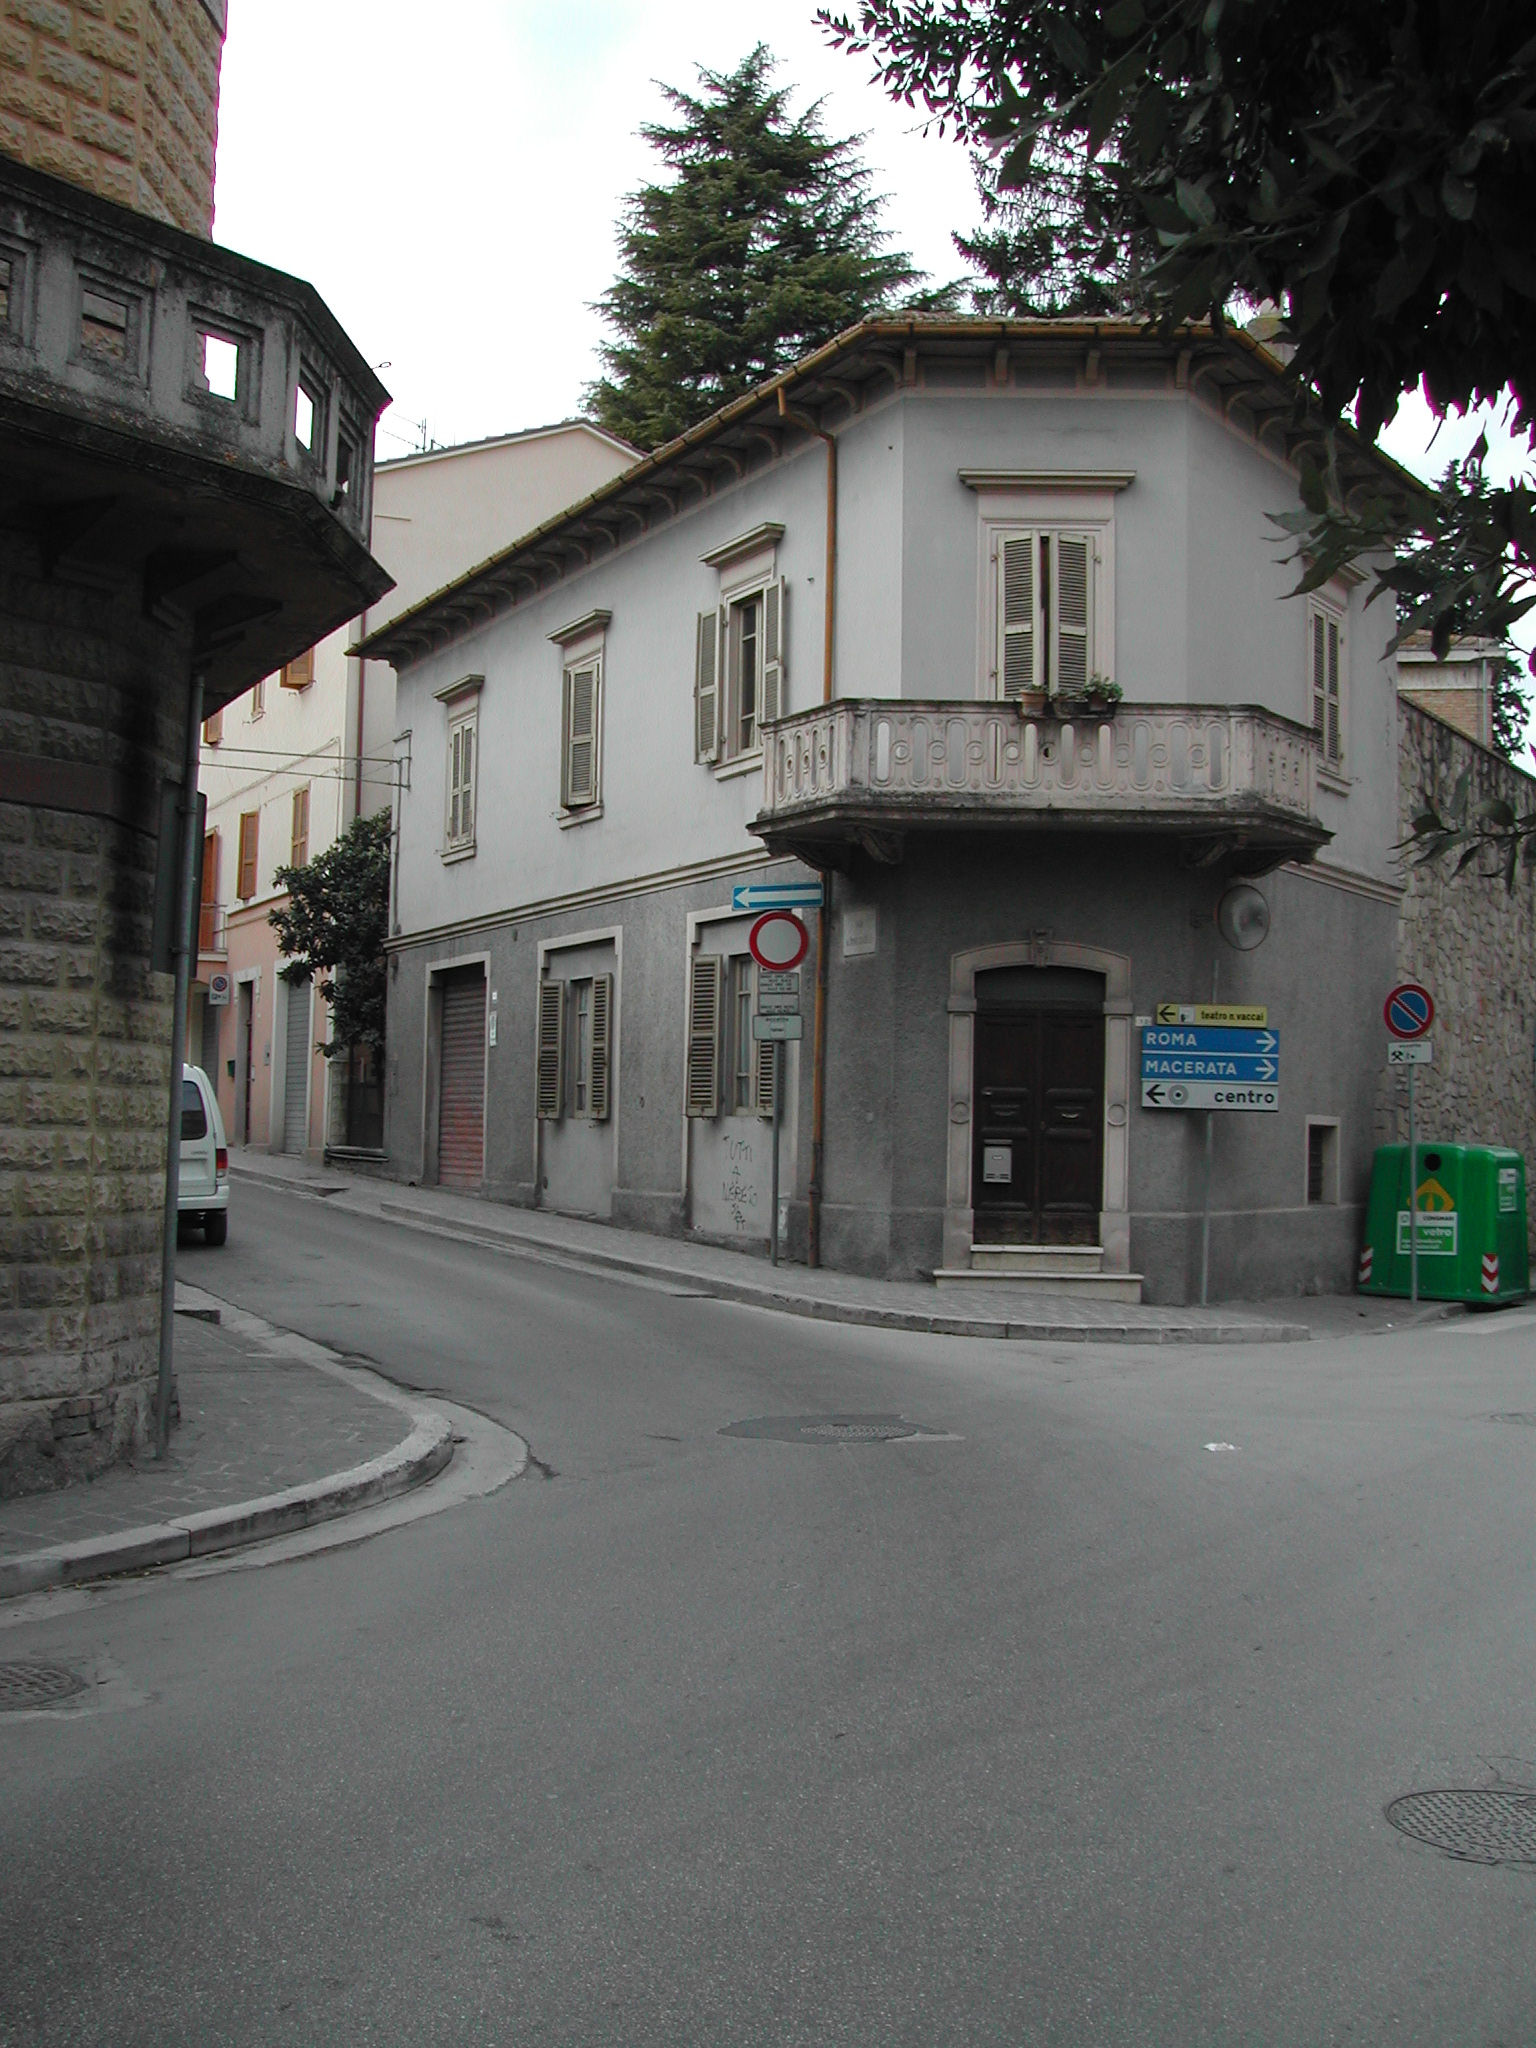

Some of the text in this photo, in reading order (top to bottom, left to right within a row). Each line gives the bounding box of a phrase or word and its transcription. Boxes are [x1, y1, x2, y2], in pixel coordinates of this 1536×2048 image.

[1201, 1010, 1228, 1020] teatro
[1146, 1032, 1197, 1046] ROMA
[1145, 1060, 1237, 1075] MACERATA
[1214, 1090, 1275, 1104] centro
[1423, 1227, 1453, 1236] vetro
